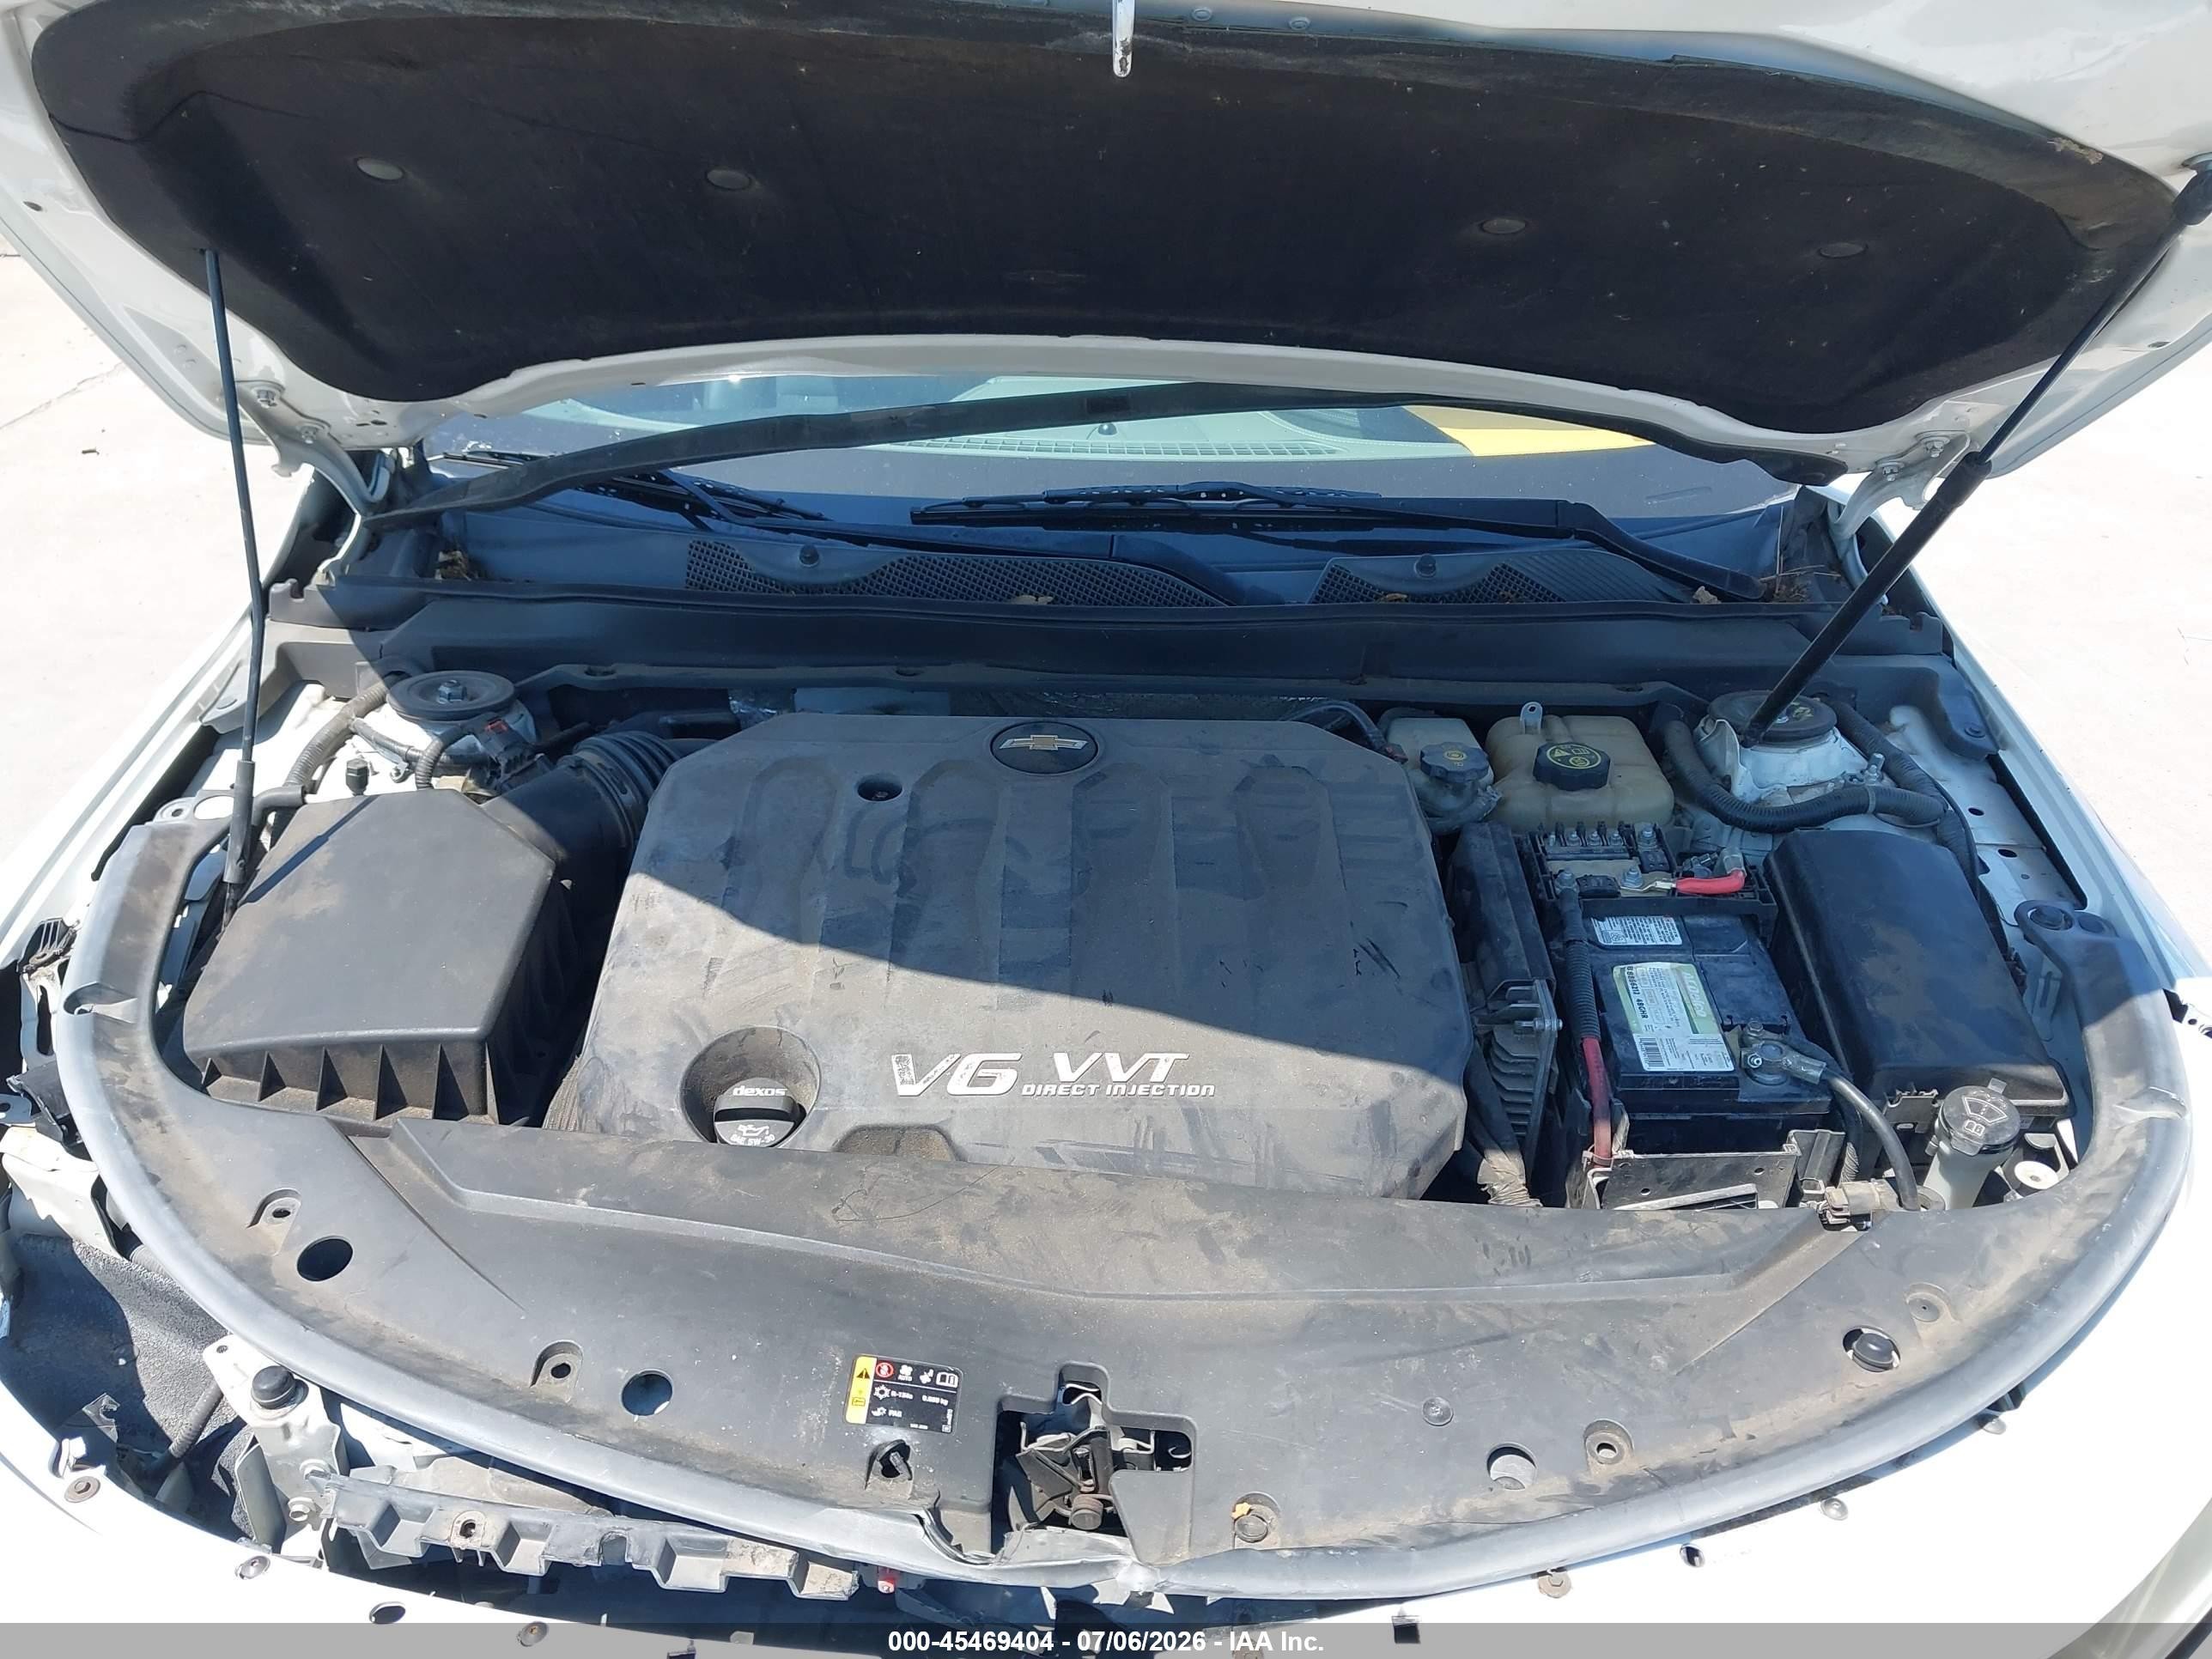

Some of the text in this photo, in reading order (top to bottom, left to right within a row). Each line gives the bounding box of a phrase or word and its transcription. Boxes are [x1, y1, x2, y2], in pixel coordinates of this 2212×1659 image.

[891, 1053, 1190, 1097] V6 VVT
[733, 1085, 787, 1097] dexos
[1021, 1085, 1101, 1097] DIRECT
